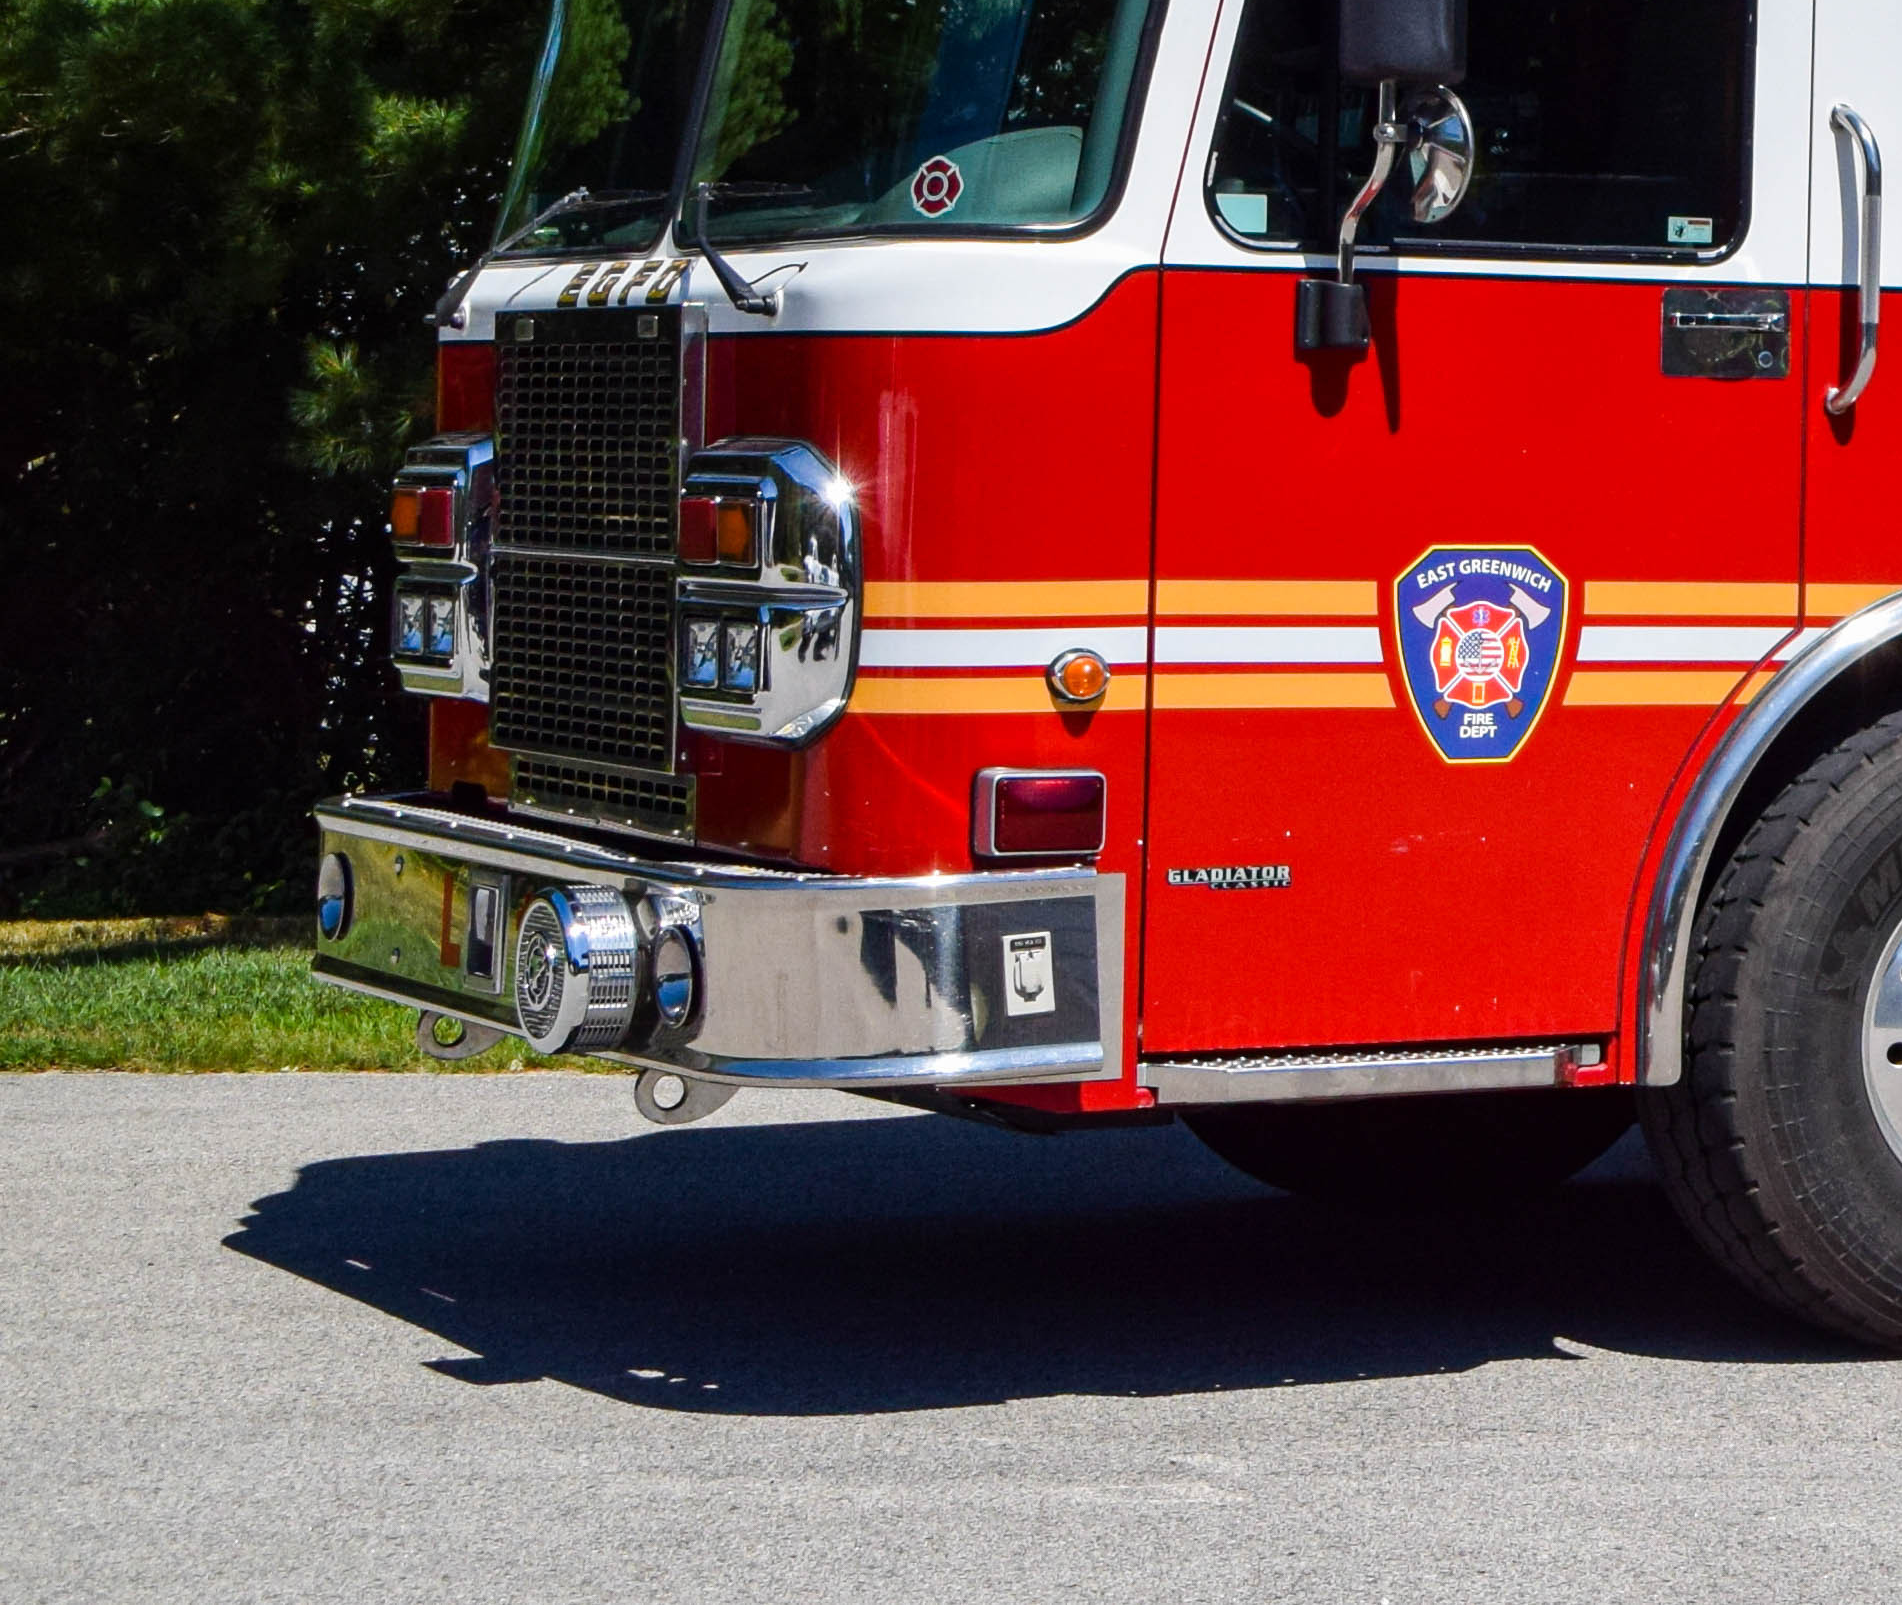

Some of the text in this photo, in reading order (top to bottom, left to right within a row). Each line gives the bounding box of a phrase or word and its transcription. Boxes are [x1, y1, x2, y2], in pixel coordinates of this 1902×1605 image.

[557, 259, 691, 308] EGFD
[1416, 559, 1552, 593] EAST GREENWICH
[1463, 712, 1494, 726] FIRE
[1459, 726, 1497, 738] DEPT
[1168, 865, 1290, 883] GLADIATOR
[1210, 880, 1292, 889] CLASSIC
